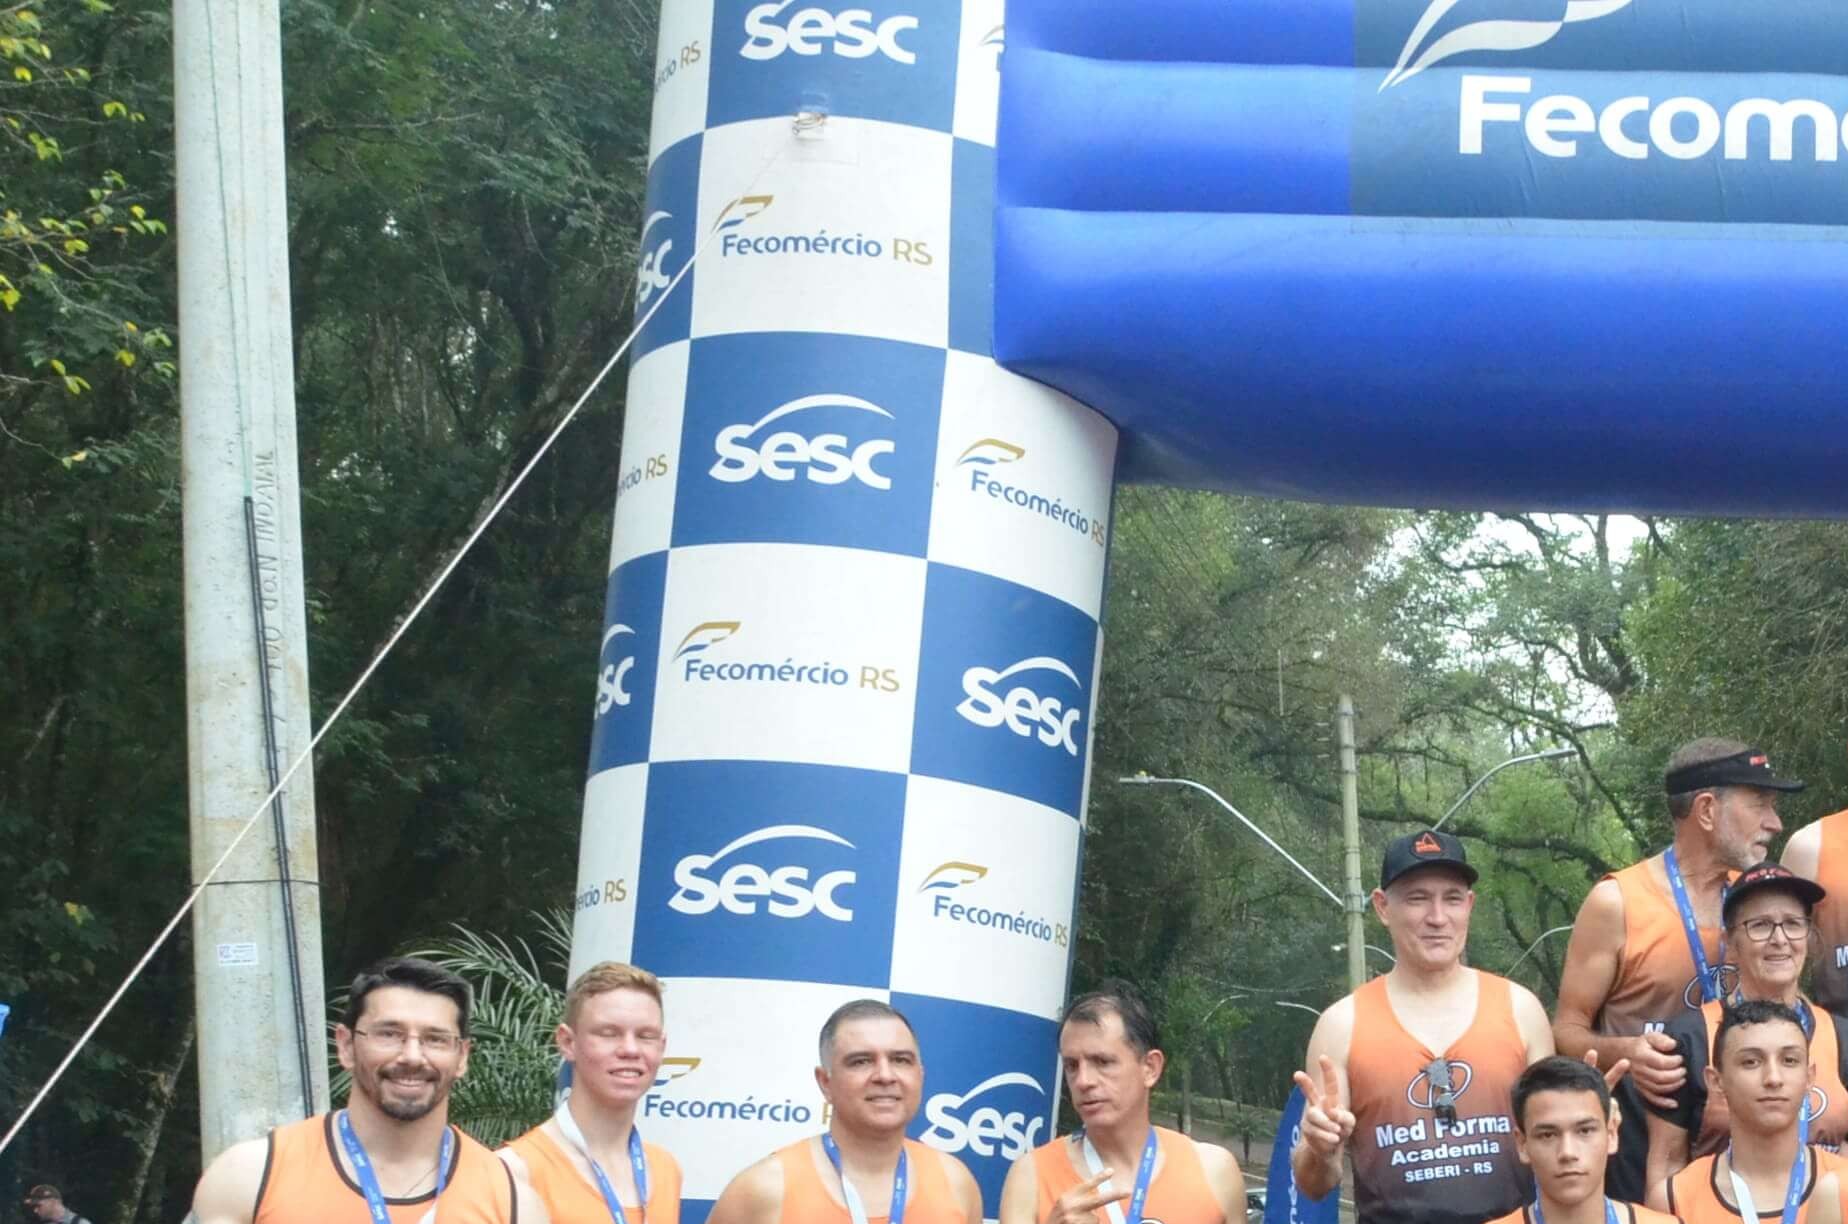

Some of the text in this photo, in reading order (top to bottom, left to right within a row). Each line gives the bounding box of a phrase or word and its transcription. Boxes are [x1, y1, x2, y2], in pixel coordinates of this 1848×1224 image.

[680, 43, 702, 69] RS
[721, 229, 933, 267] Fecomércio RS
[645, 453, 669, 481] RS
[970, 471, 1090, 536] Fecomércio
[684, 656, 901, 693] Fecomércio RS
[604, 878, 628, 904] RS
[933, 893, 1053, 945] Fecomércio
[643, 1093, 812, 1125] Fecomércio
[1375, 1115, 1512, 1148] Med Forma
[1391, 1138, 1501, 1166] Academia
[1404, 1161, 1494, 1184] SEBERI RS
